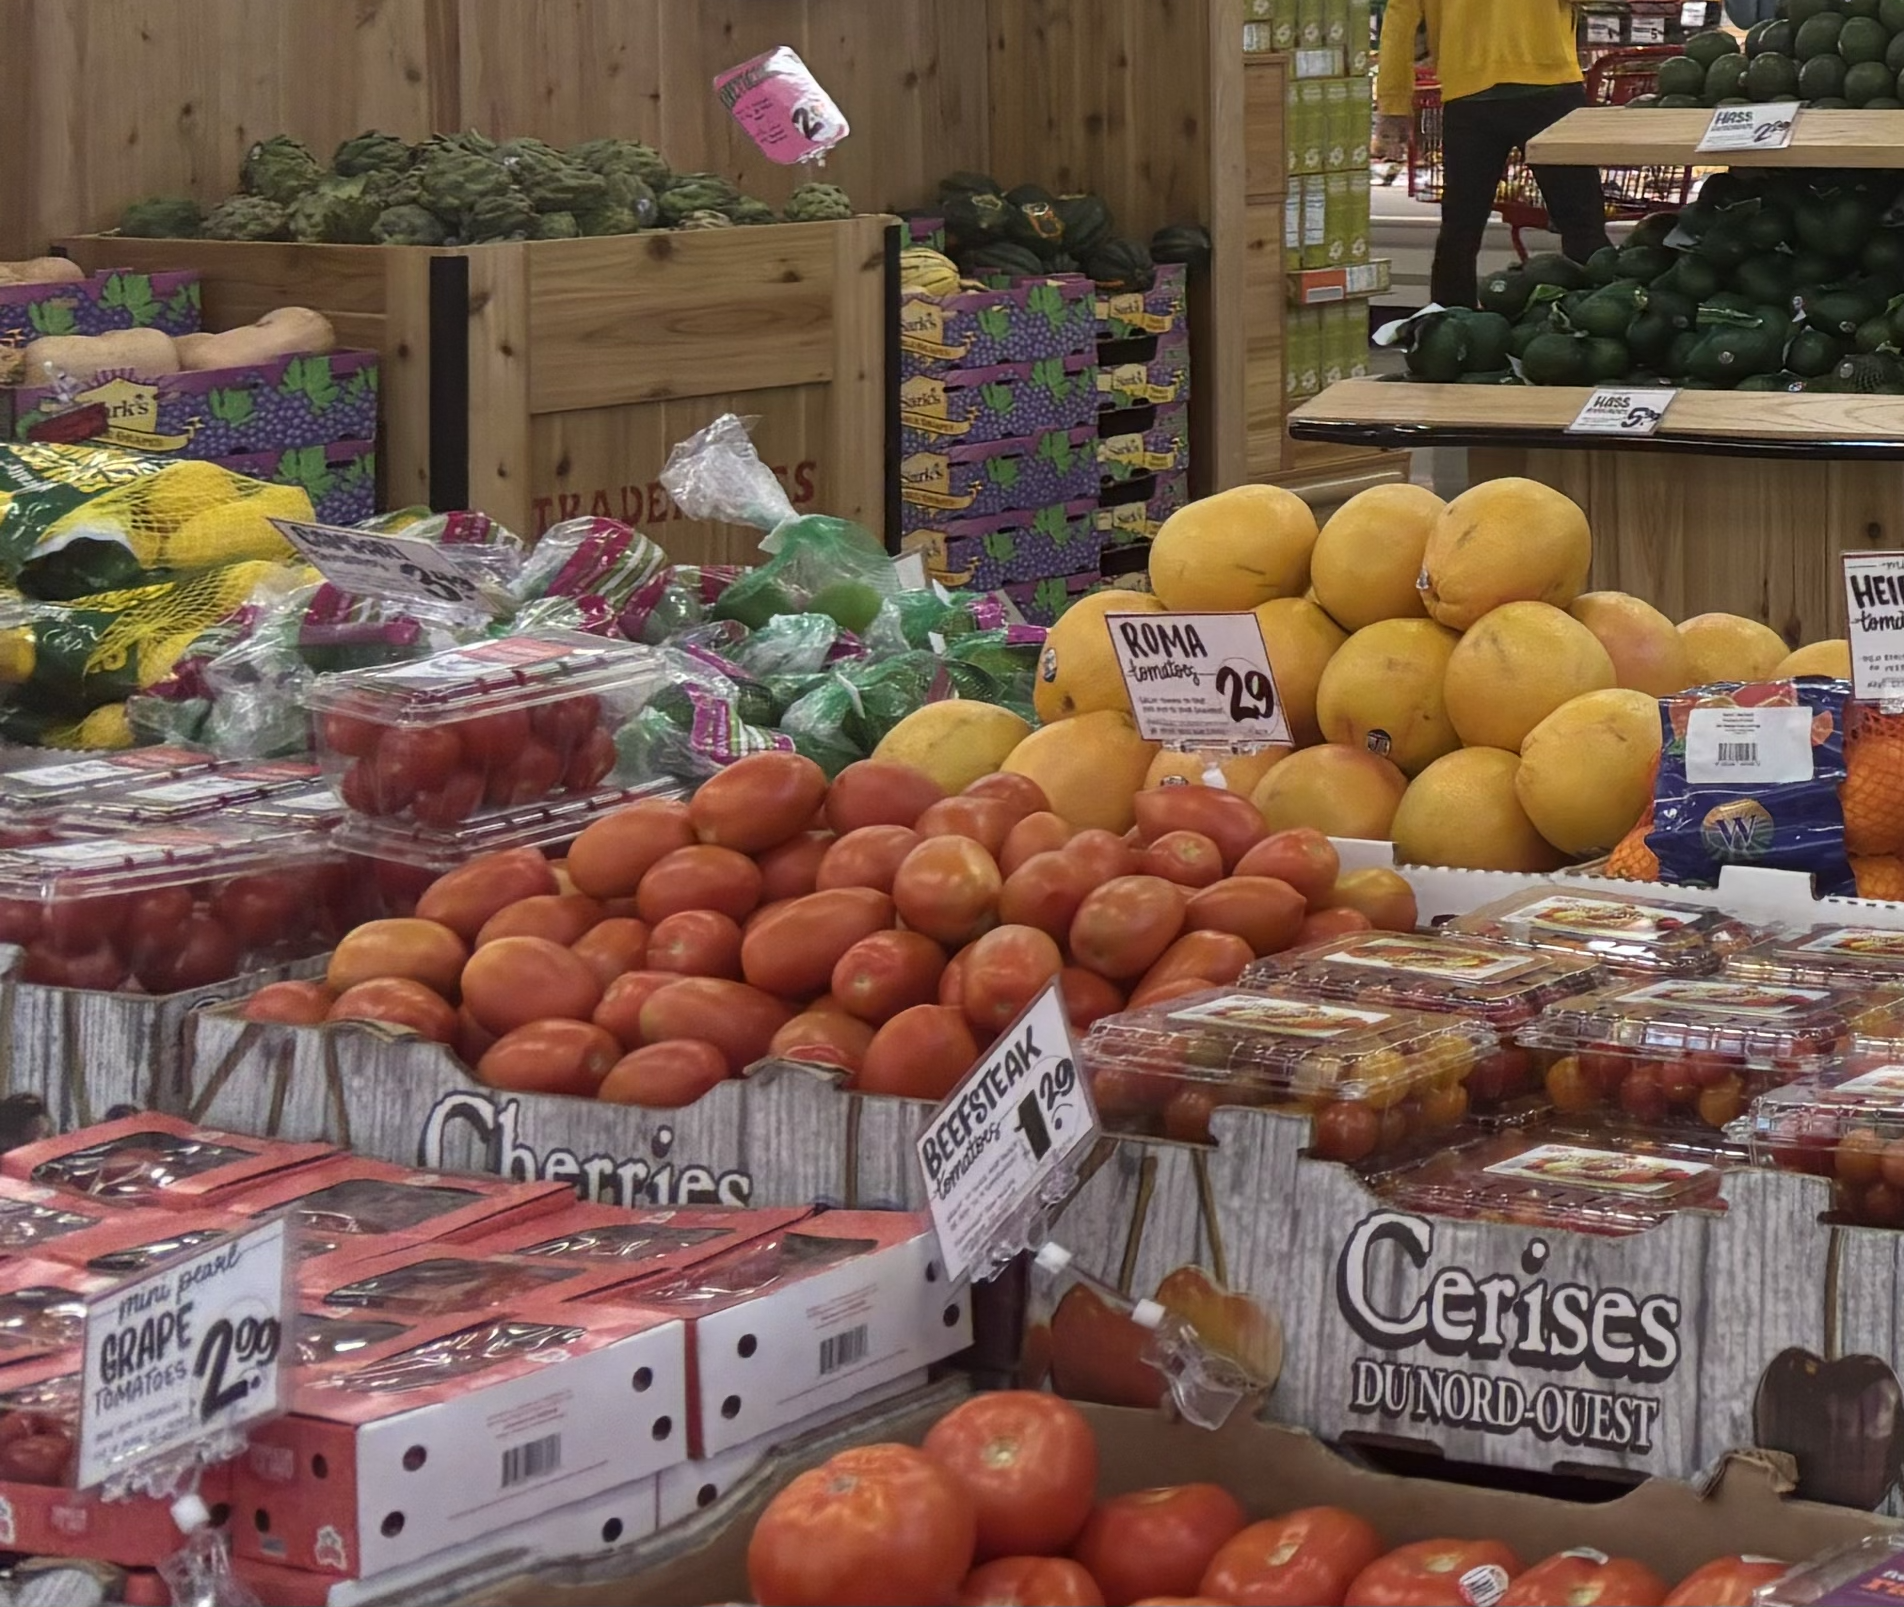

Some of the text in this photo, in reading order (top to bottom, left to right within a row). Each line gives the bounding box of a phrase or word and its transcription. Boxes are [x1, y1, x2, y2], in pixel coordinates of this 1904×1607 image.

[1715, 112, 1753, 124] HASS
[107, 393, 150, 417] ark's
[1593, 396, 1631, 408] HASS
[1120, 622, 1208, 659] ROMA
[1128, 659, 1200, 686] tomatoes
[1216, 666, 1275, 722] 29
[1715, 815, 1757, 854] W
[921, 1024, 1043, 1181] BEEFSTEAK
[934, 1122, 1001, 1201] tomatoes
[1014, 1058, 1076, 1162] 1.29
[418, 1090, 751, 1208] Cherries
[118, 1243, 242, 1325] mini pearl
[1338, 1210, 1682, 1380] Cerises
[94, 1360, 188, 1417] TOMATOES
[101, 1301, 282, 1423] GRAPE 2.99
[1351, 1358, 1659, 1448] DU NORD-OUEST
